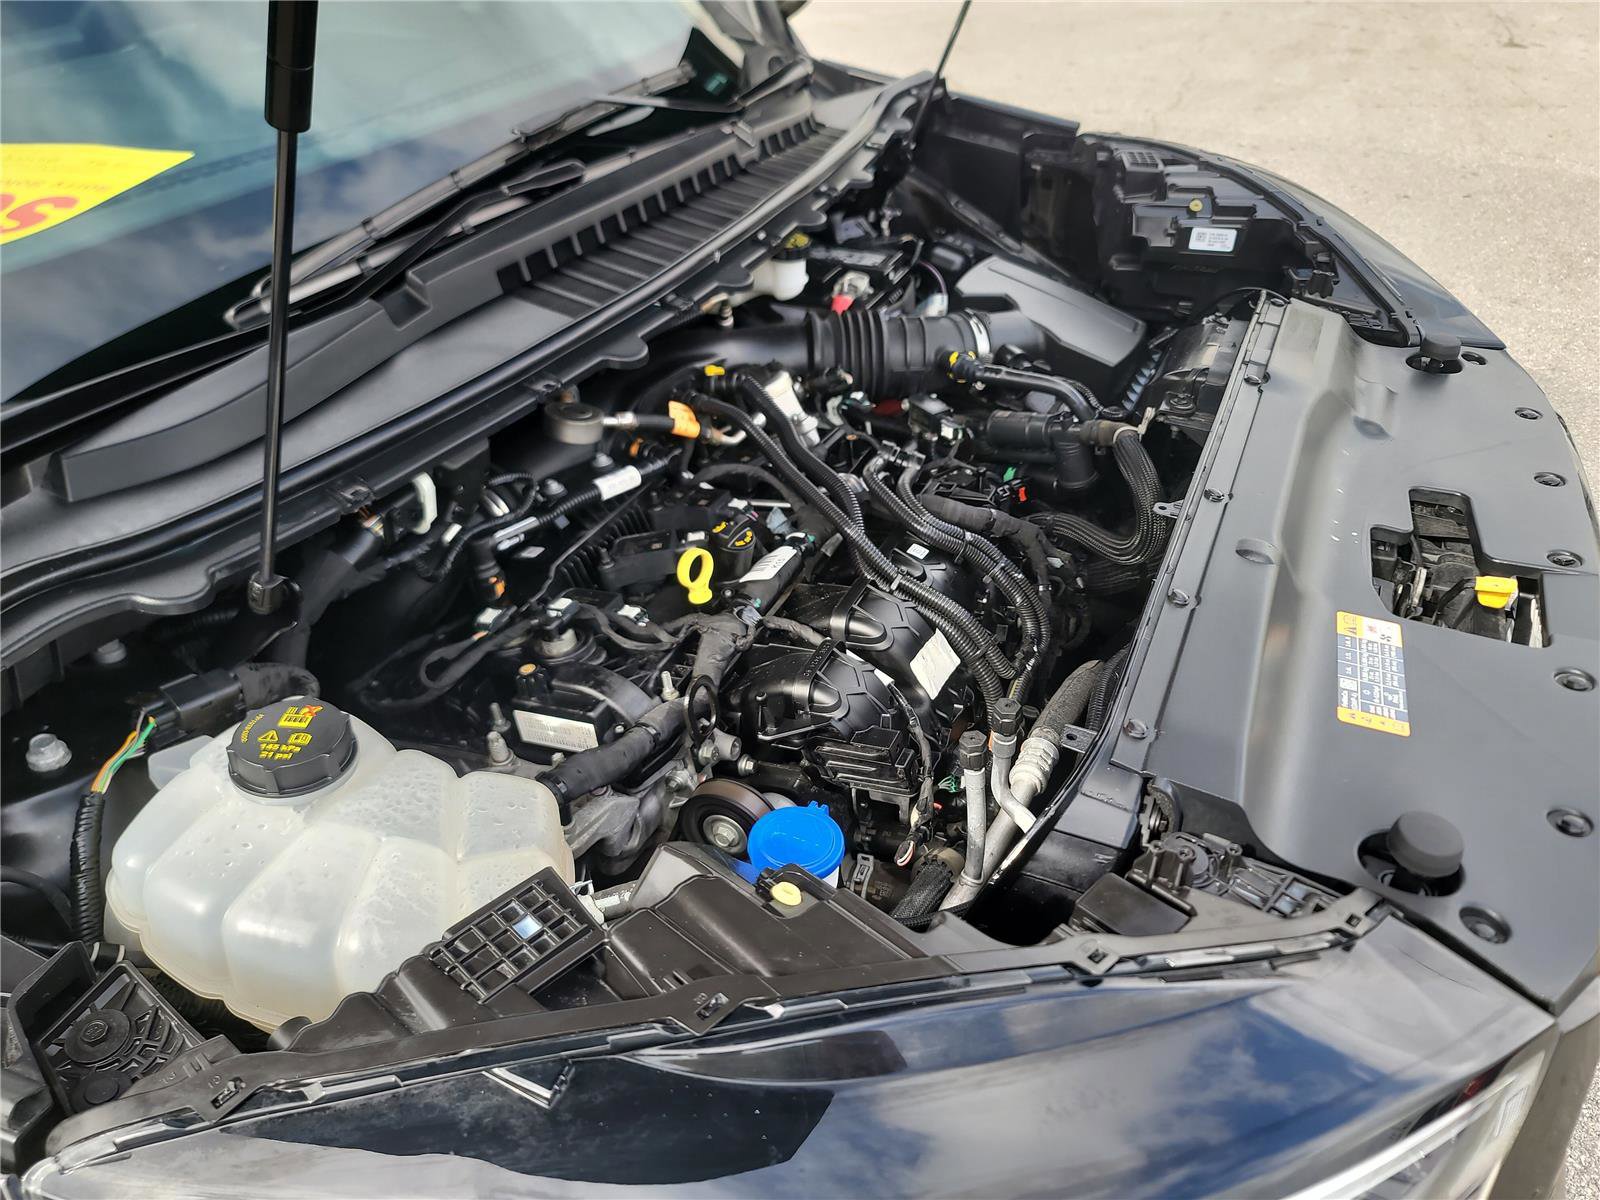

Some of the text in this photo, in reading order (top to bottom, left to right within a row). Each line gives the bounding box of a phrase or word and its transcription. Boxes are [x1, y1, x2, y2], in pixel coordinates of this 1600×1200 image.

[0, 192, 79, 233] S
[280, 744, 302, 753] kPa
[259, 751, 294, 760] 21 psi
